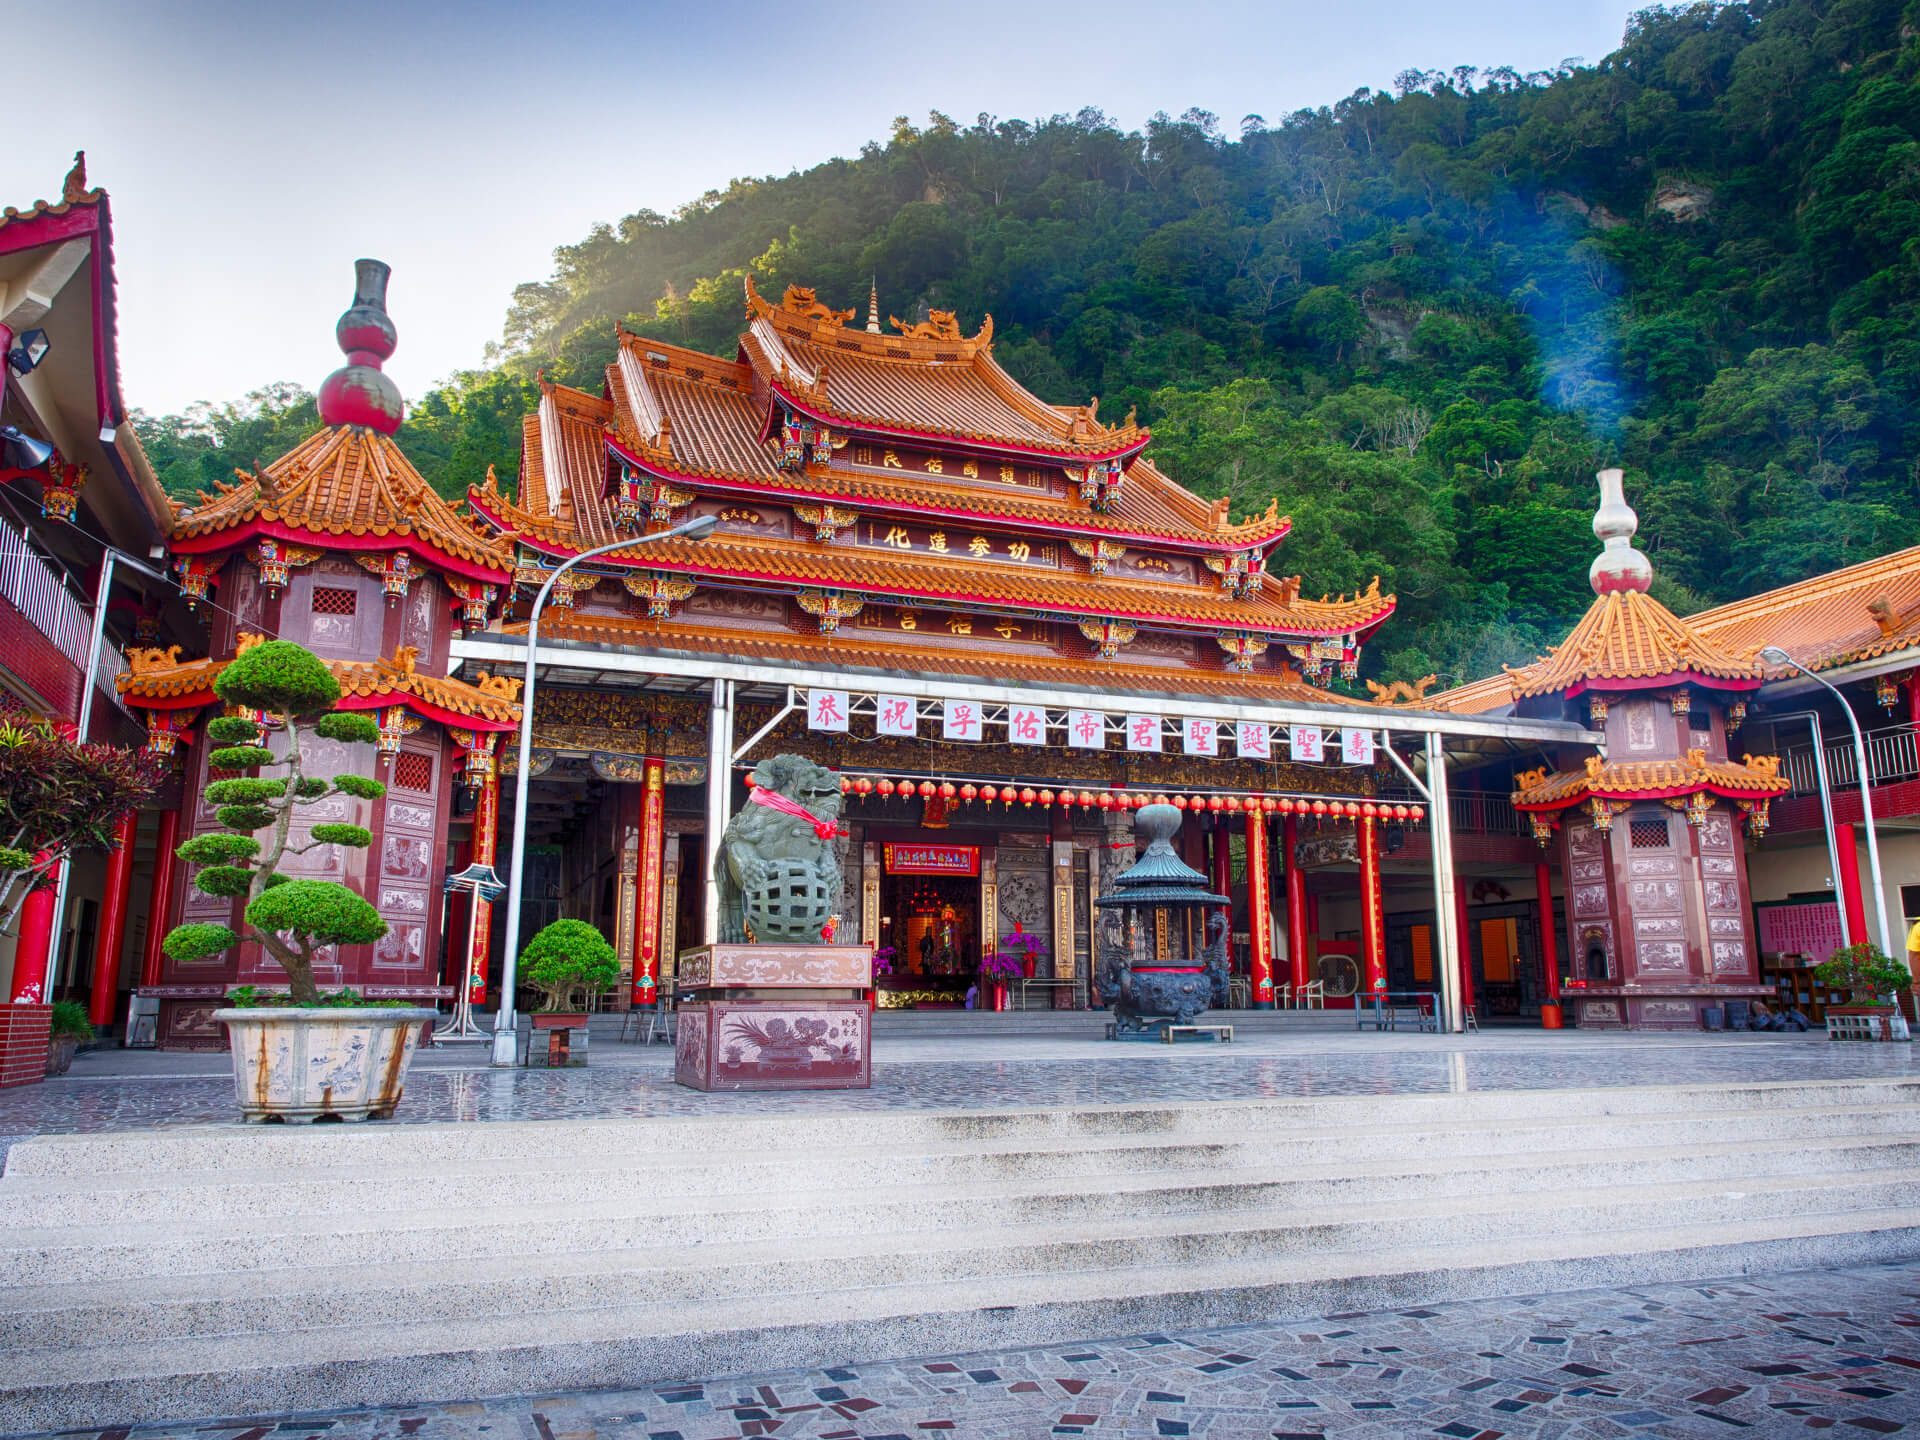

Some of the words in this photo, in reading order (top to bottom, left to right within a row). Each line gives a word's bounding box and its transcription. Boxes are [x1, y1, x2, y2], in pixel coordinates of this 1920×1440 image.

[883, 524, 1032, 563] 功參造化
[814, 694, 1367, 762] 恭祝孚佑帝君聖誕聖壽
